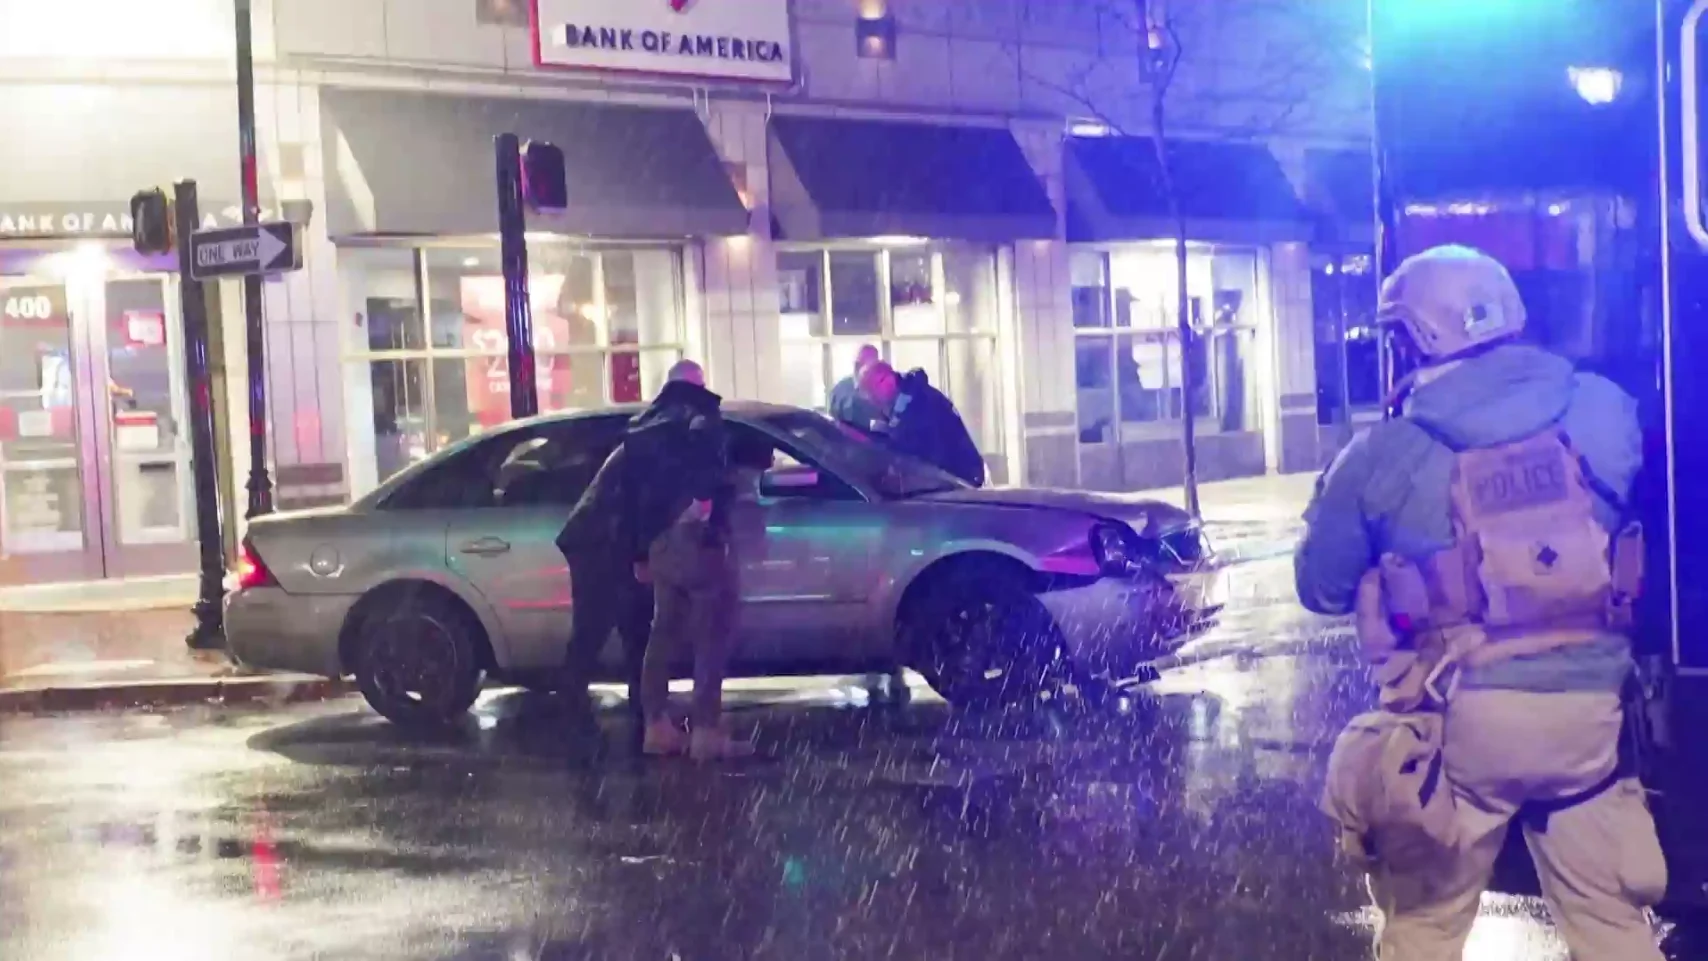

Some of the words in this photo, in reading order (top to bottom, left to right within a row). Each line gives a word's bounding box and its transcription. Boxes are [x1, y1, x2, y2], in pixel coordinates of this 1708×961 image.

[564, 24, 633, 49] BANK
[641, 30, 671, 51] OF
[678, 34, 783, 61] AMERICA
[0, 212, 54, 232] ANK
[62, 212, 95, 231] OF
[200, 244, 225, 264] ONE
[232, 240, 260, 260] WAY
[5, 294, 51, 319] 400
[1474, 463, 1563, 501] POLICE
